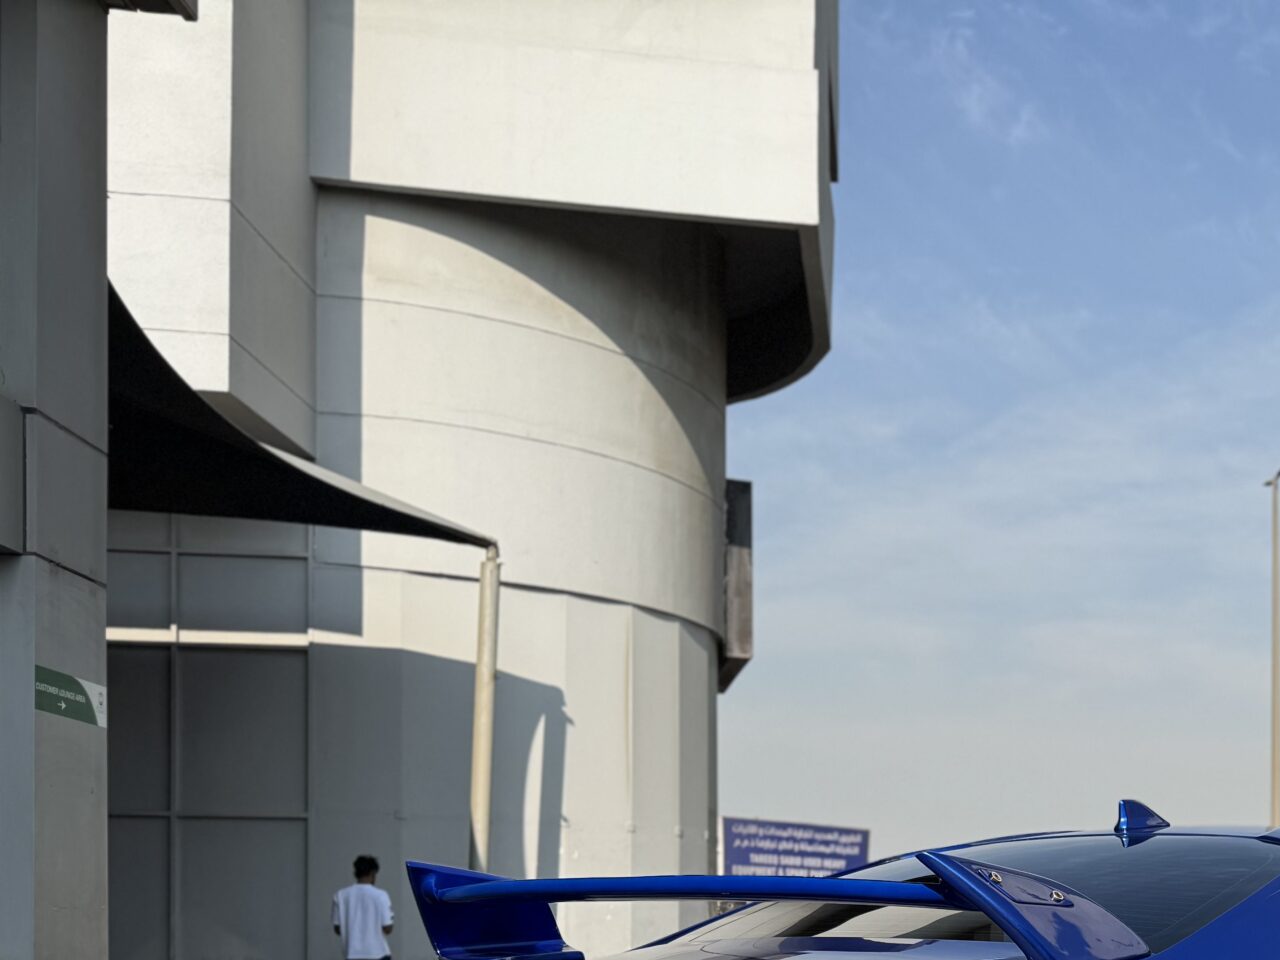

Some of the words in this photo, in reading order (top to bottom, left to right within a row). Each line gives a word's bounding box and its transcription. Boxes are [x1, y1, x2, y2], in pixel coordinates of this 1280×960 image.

[36, 682, 58, 695] CUSTOMER
[59, 688, 76, 701] LOUNGE
[76, 693, 86, 703] AREA
